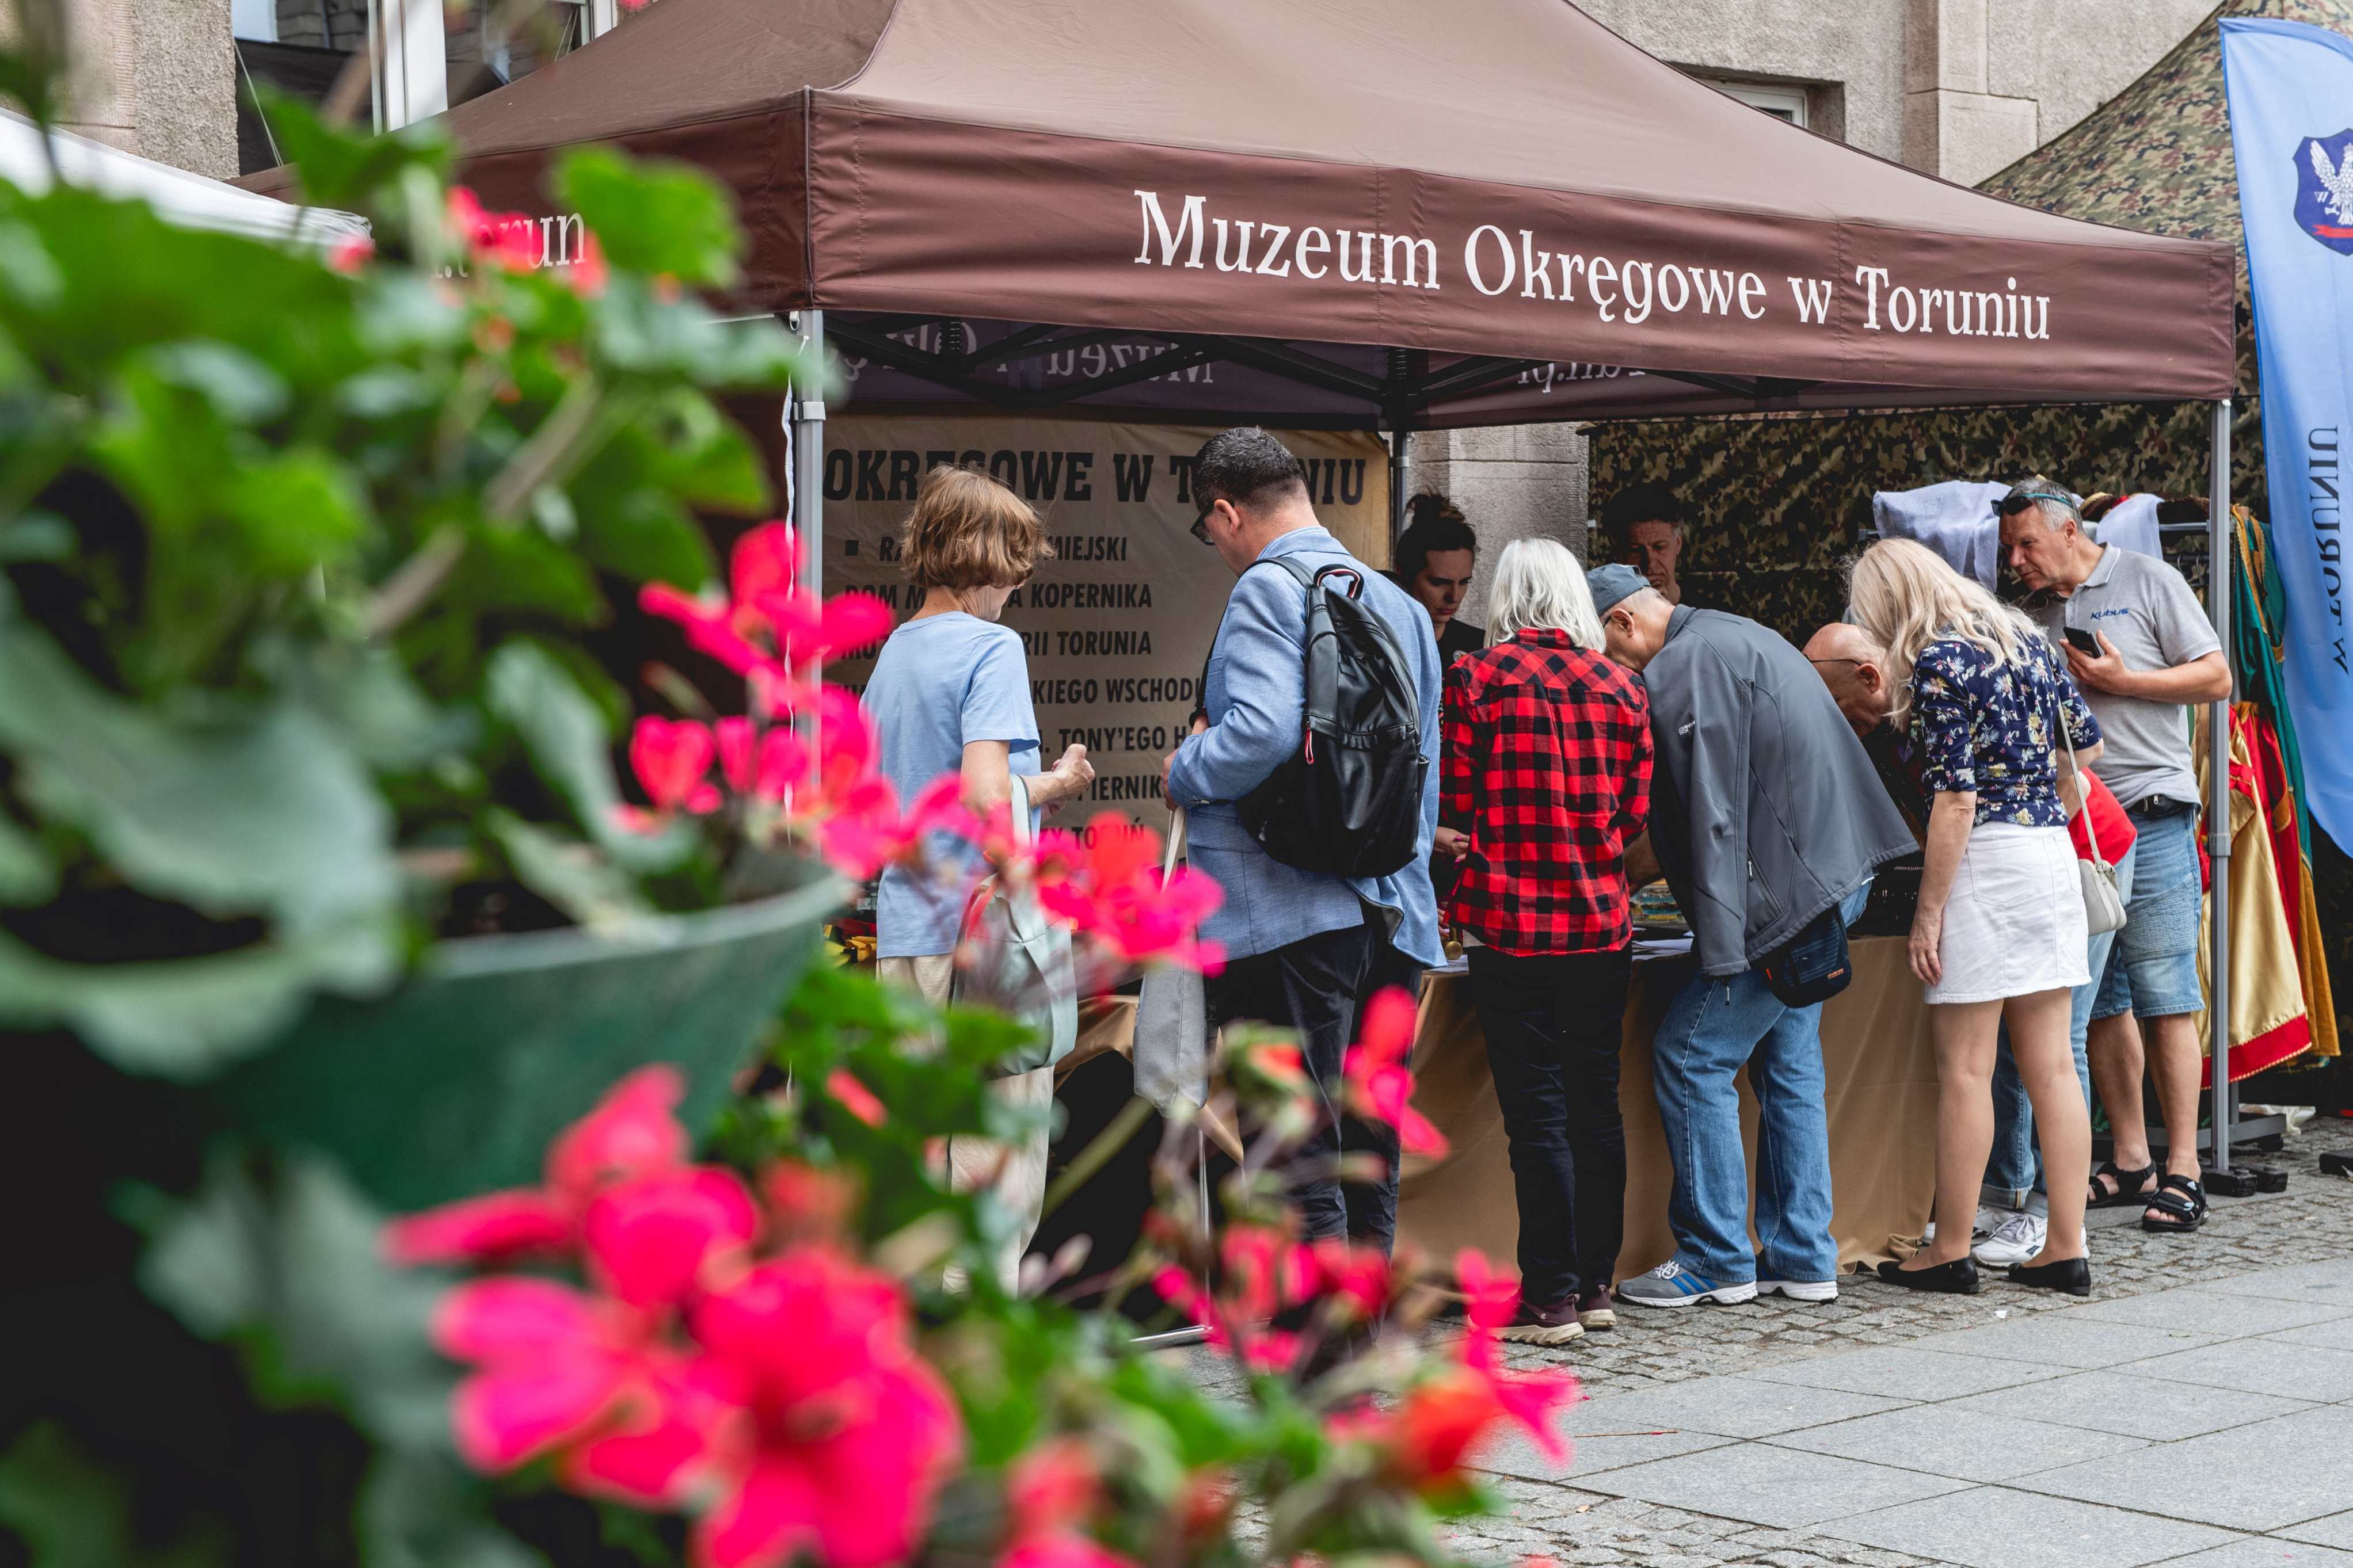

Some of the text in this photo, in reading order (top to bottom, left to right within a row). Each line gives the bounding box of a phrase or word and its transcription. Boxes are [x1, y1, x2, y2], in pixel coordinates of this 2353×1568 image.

[1134, 189, 2051, 340] Muzeum Okręgowe w Toruniu
[1113, 453, 1153, 502] W
[1170, 455, 1366, 505] TNIU
[1030, 583, 1152, 608] KOPERNIKA
[1057, 631, 1151, 655] TORUNIA
[1030, 679, 1098, 704] KIEGO
